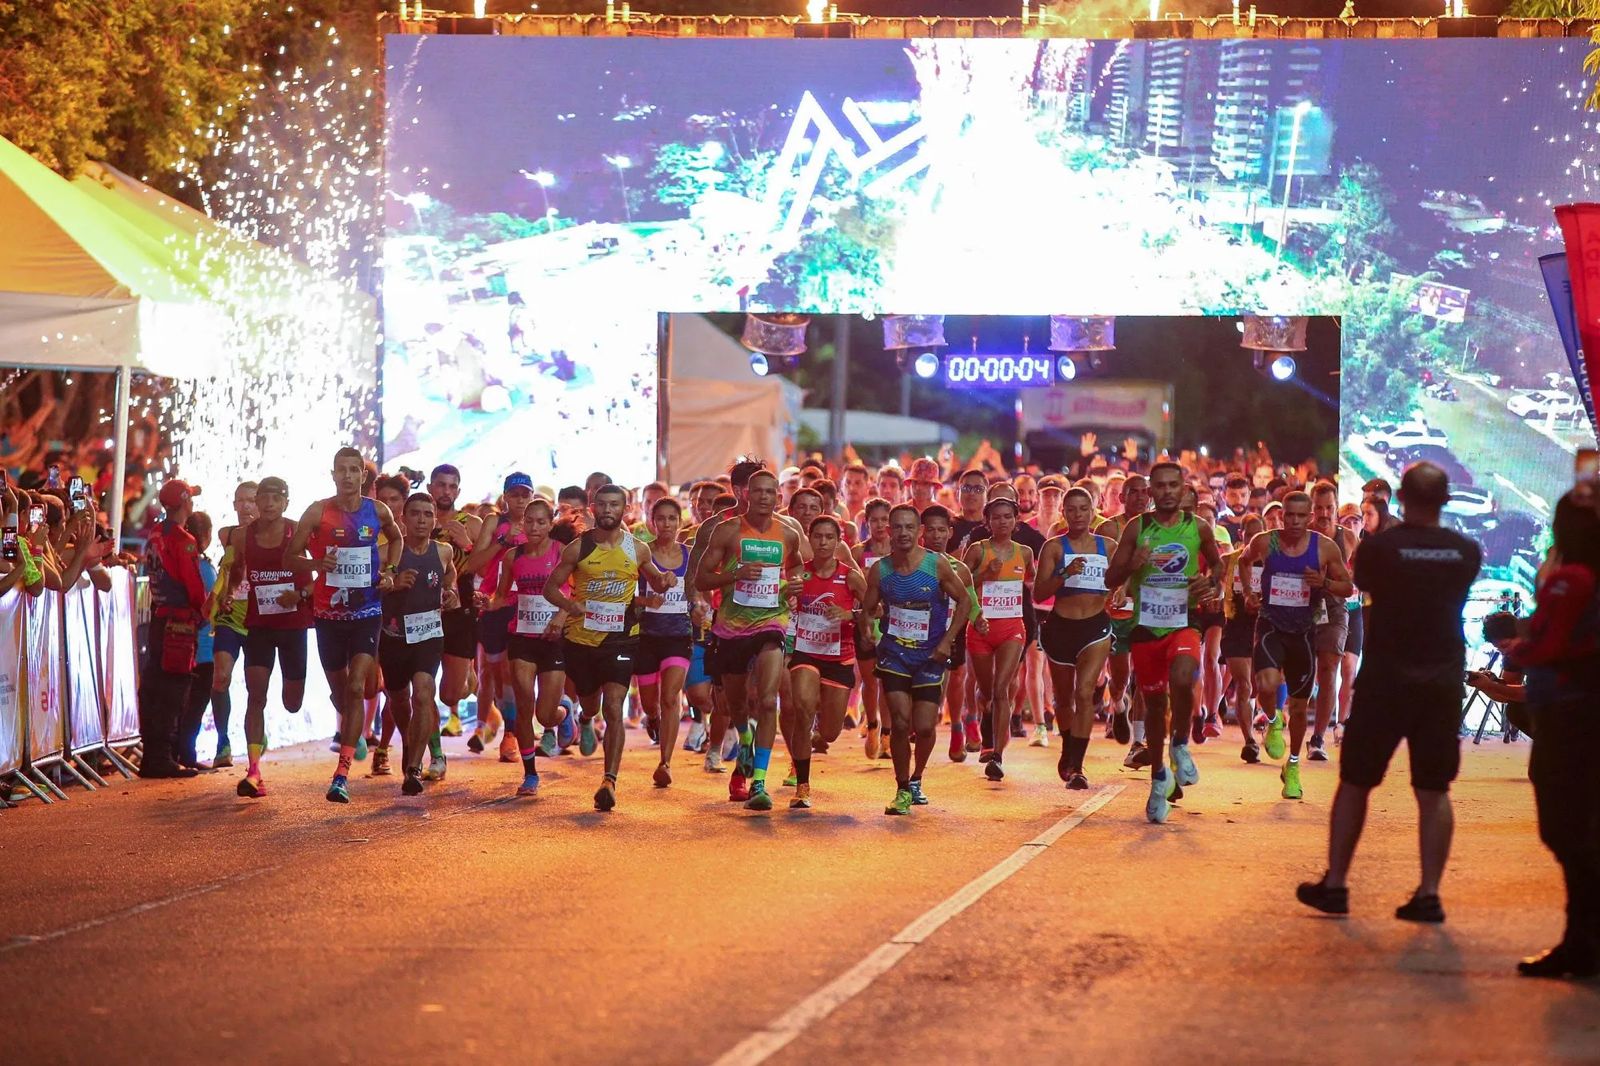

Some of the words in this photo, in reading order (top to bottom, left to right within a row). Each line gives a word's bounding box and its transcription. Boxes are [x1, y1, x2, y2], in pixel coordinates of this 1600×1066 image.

[260, 570, 293, 578] RUNNING
[333, 564, 366, 574] 21008
[740, 582, 775, 594] 44004
[988, 596, 1018, 606] 42010
[1149, 603, 1181, 615] 21003
[522, 611, 553, 622] 21002
[590, 612, 619, 622] 42910
[894, 619, 923, 630] 42028
[801, 630, 833, 641] 44001
